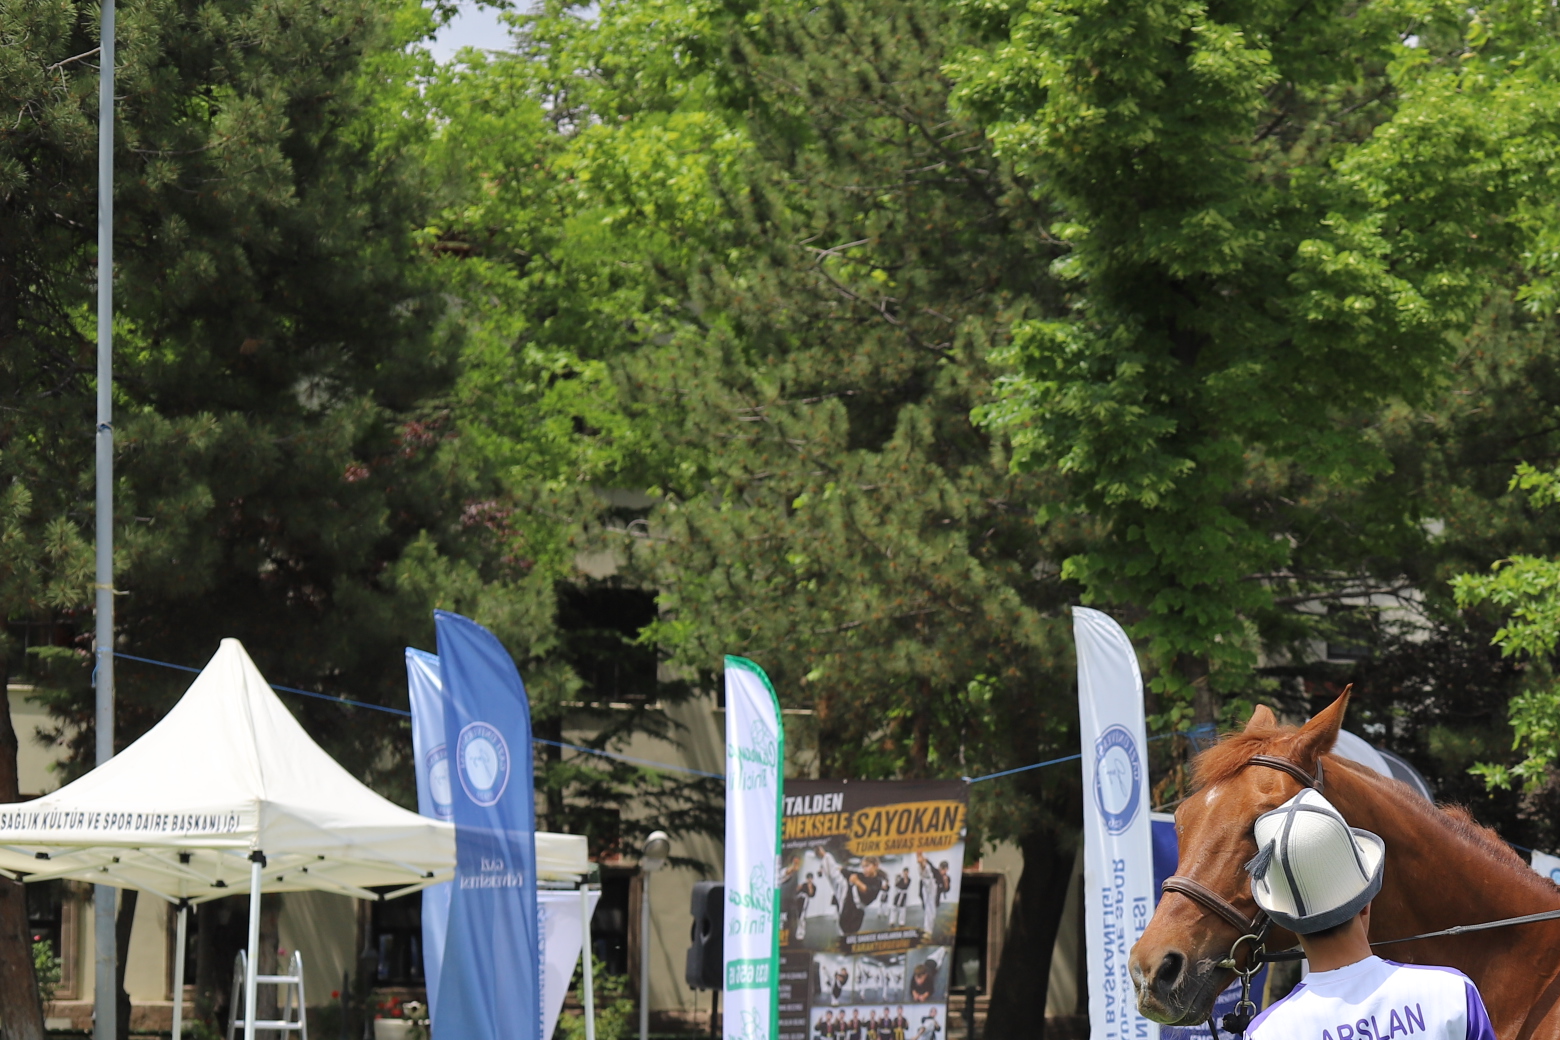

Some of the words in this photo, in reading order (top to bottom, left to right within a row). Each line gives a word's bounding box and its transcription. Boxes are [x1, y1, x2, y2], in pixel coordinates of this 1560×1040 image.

[0, 808, 39, 831] SAĞLIK
[41, 807, 84, 830] KÜLTÜR
[87, 812, 101, 831] VE
[102, 812, 133, 831] SPOR
[134, 809, 169, 832] DAİRE
[170, 811, 241, 837] BAŞKANLIĞI
[853, 806, 960, 838] SAYOKAN
[856, 840, 881, 853] TÜRK
[884, 837, 914, 851] SAVAŞ
[917, 835, 953, 847] SANATI
